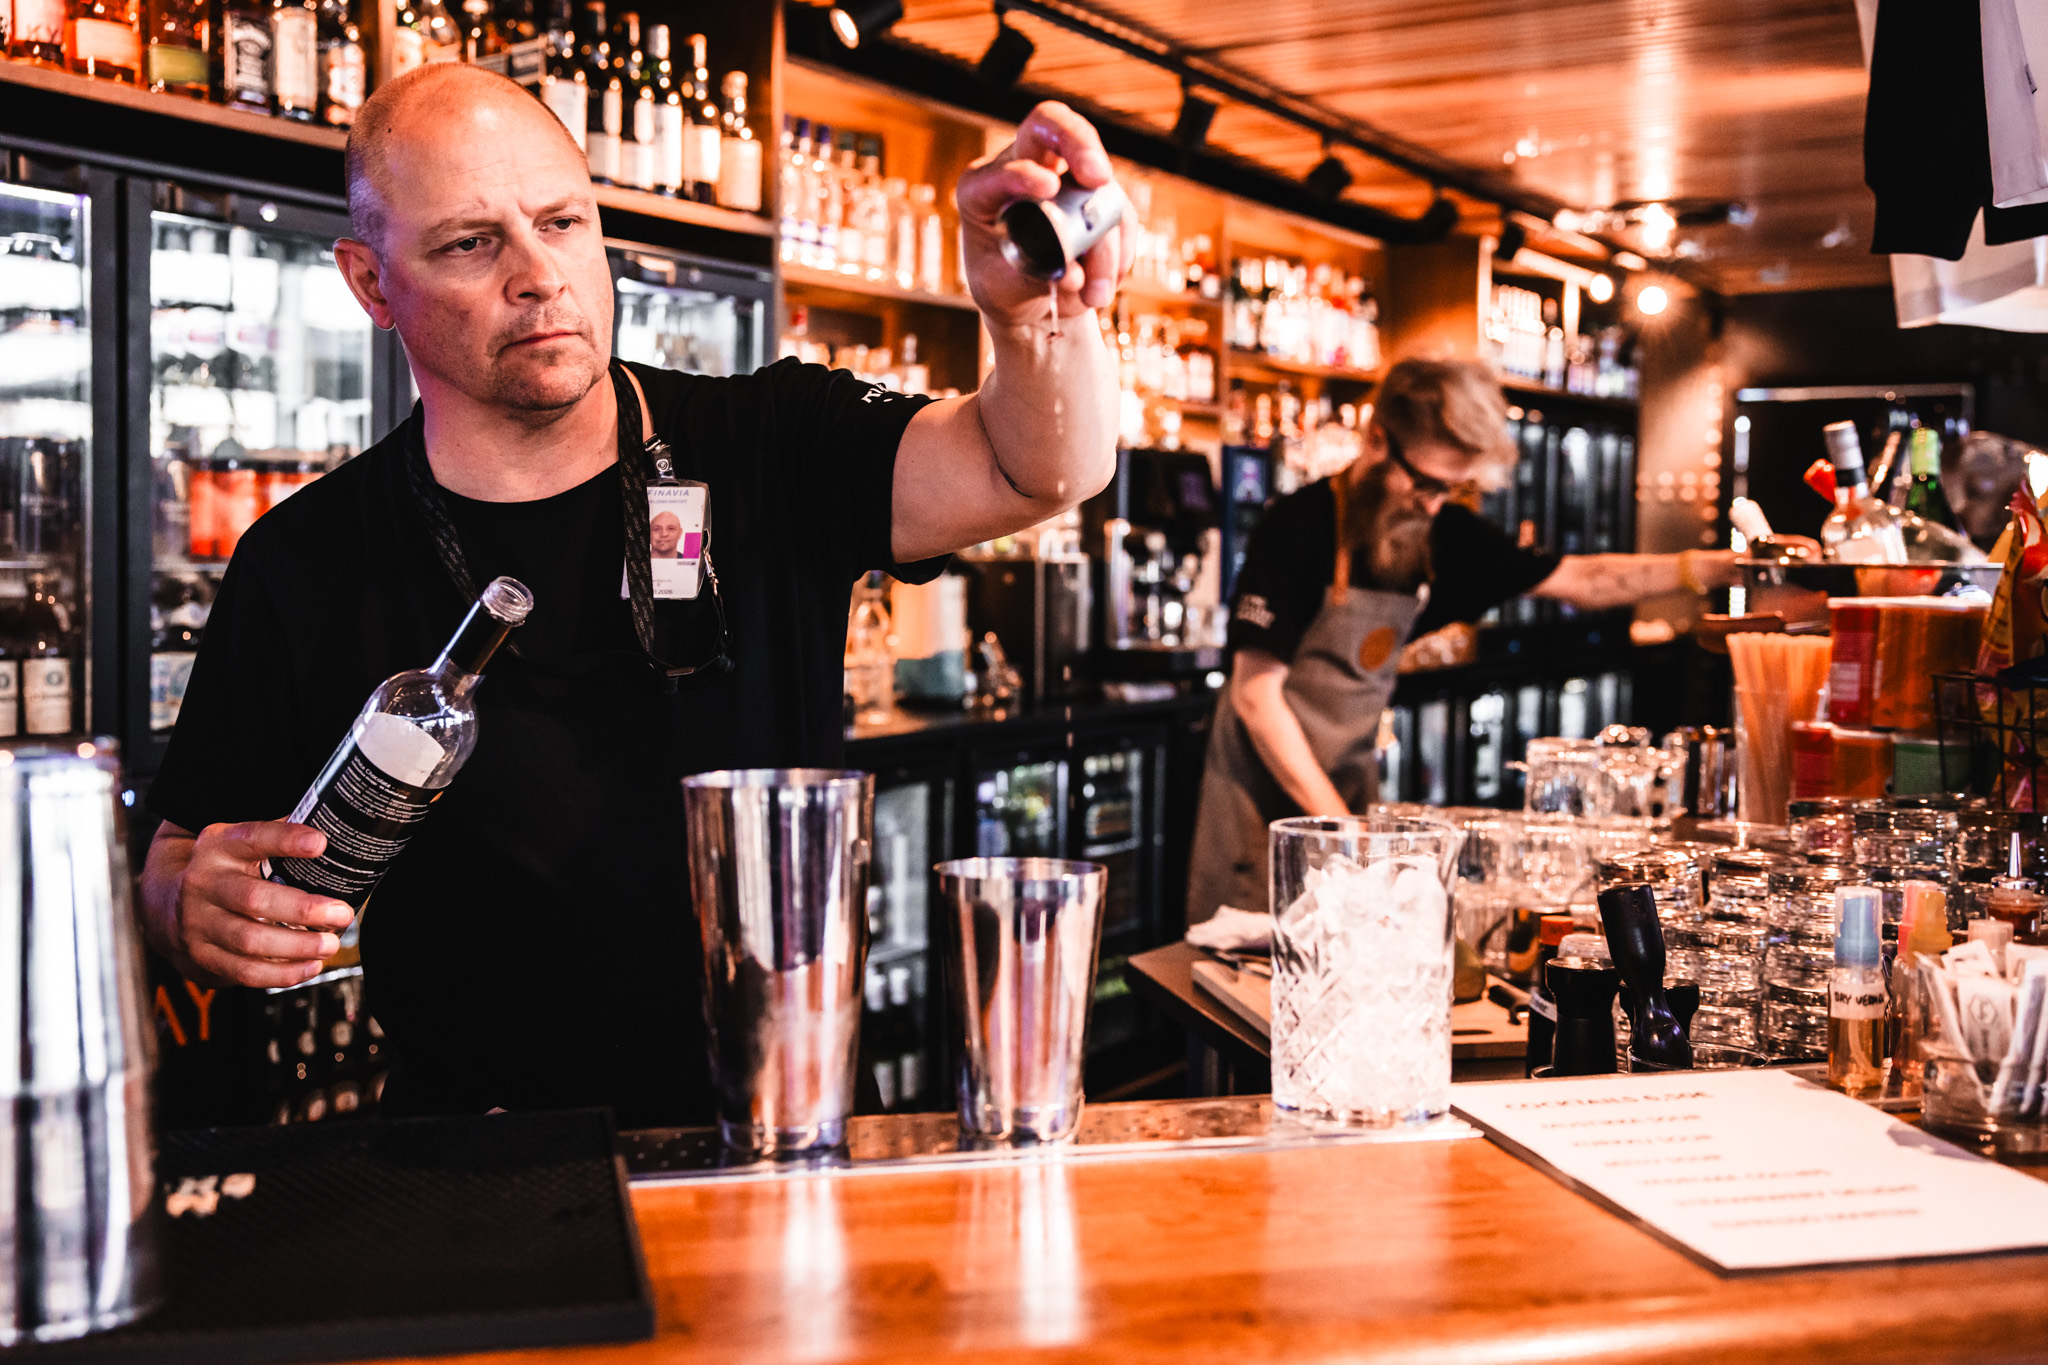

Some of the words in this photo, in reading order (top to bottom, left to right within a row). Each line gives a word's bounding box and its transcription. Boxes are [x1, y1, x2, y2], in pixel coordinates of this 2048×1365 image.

[648, 489, 690, 497] FINAVIA
[354, 755, 366, 771] White
[366, 768, 391, 788] Chocolate
[1834, 991, 1852, 1005] DRY
